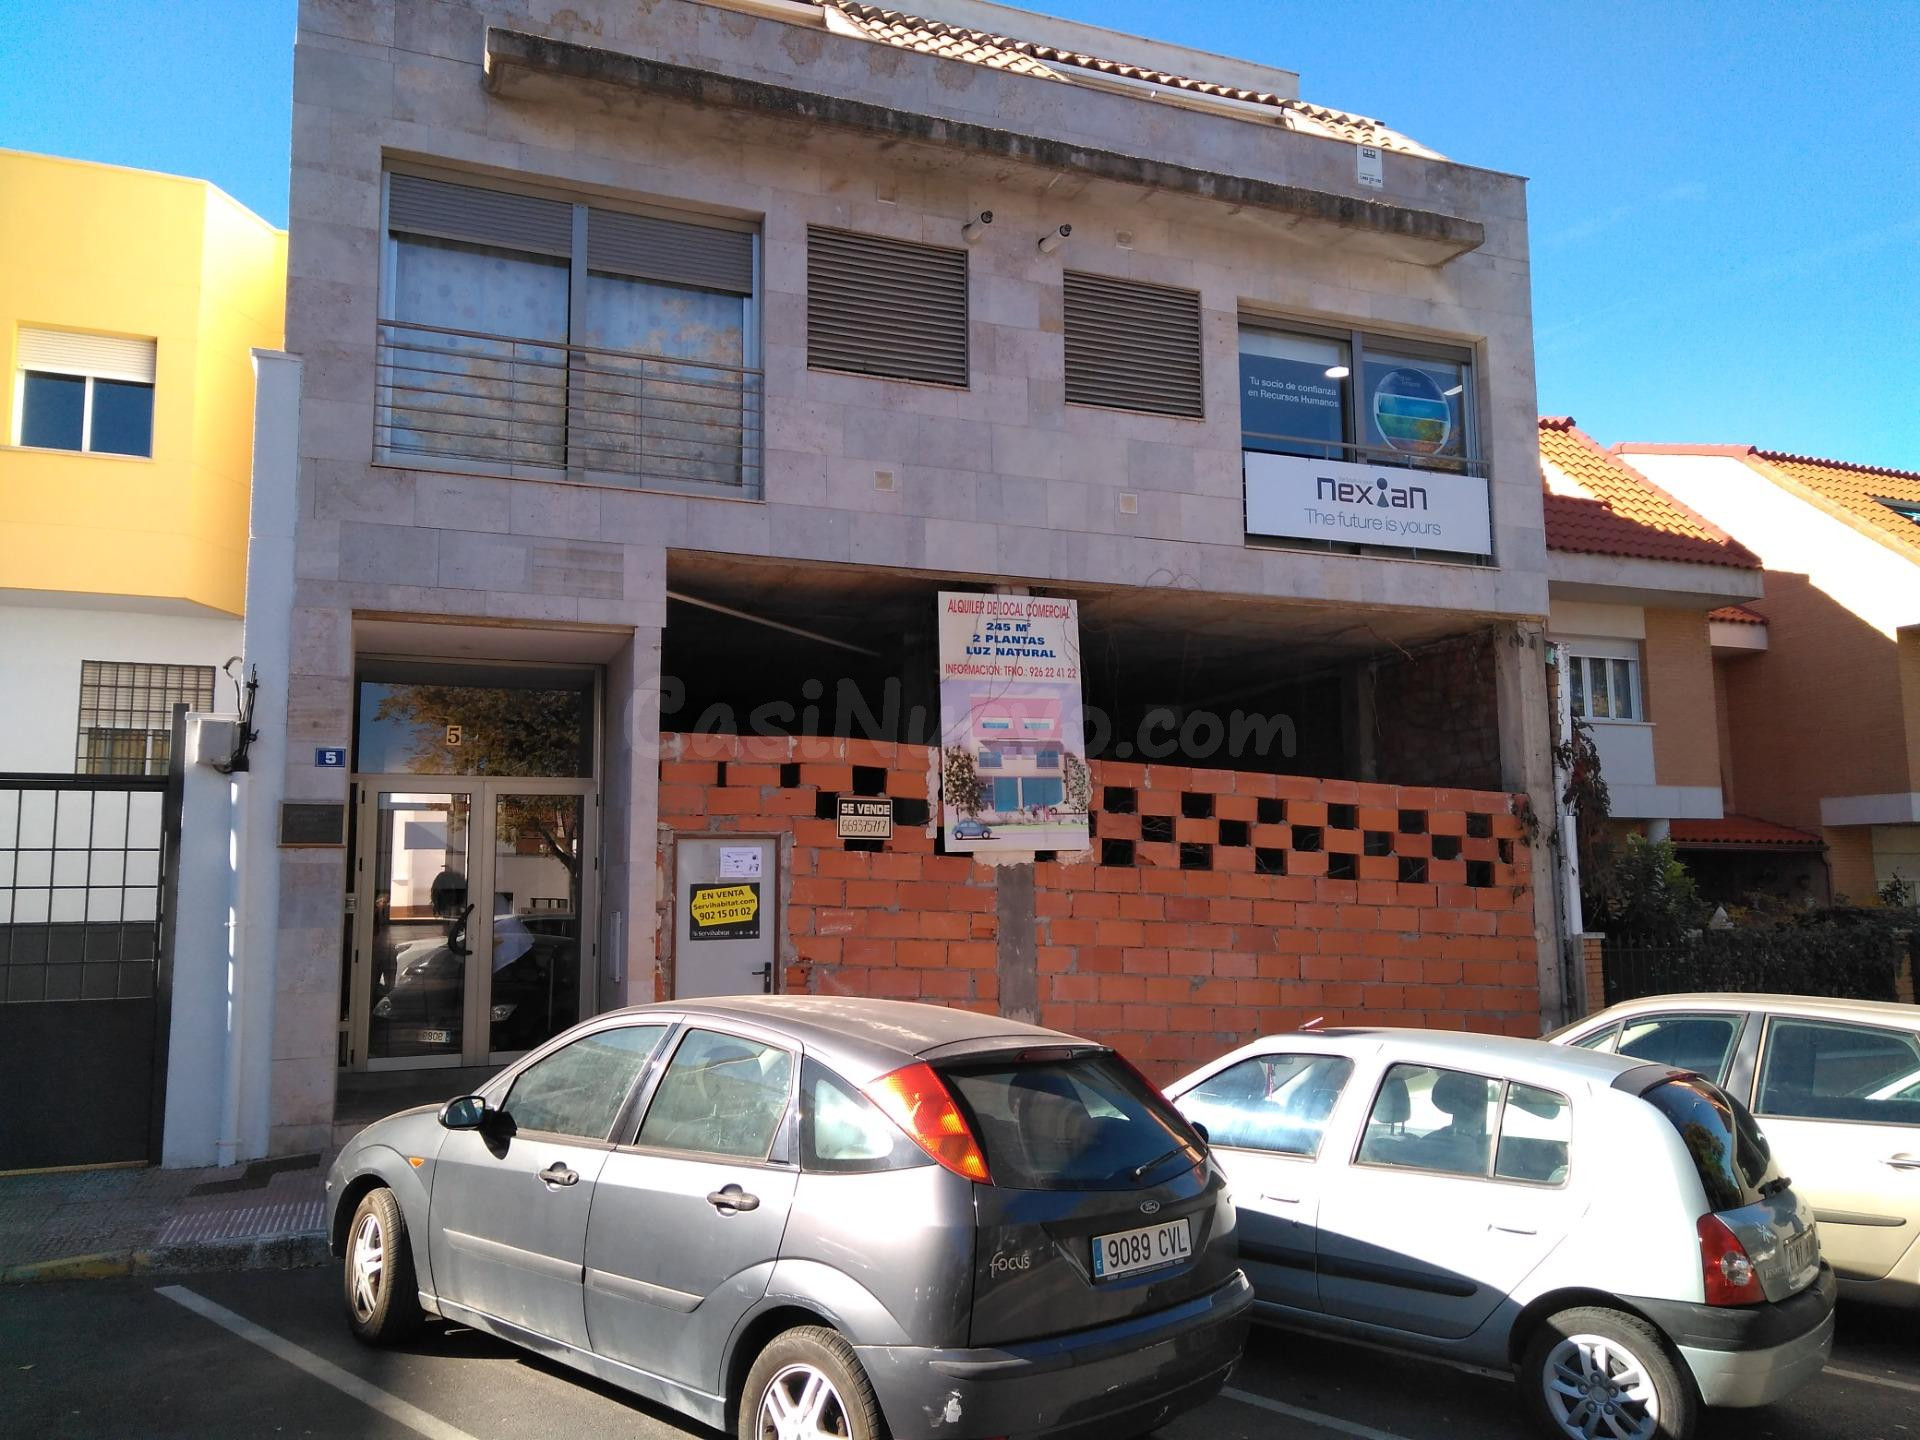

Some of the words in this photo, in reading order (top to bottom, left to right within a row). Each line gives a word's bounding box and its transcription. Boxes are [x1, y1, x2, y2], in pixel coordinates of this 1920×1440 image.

[1250, 376, 1259, 385] Tu
[1262, 379, 1283, 389] socio
[1286, 382, 1295, 390] de
[1298, 385, 1336, 395] confianza
[1248, 389, 1258, 397] en
[1260, 389, 1299, 402] Recursos
[1301, 395, 1339, 407] Humanos
[1304, 508, 1335, 525] The
[1338, 511, 1382, 530] future
[1386, 516, 1397, 531] is
[1400, 520, 1441, 535] yours
[948, 600, 984, 615] ALQUILER
[987, 602, 997, 615] DE
[999, 603, 1023, 616] LOCAL
[1026, 604, 1070, 619] COMERCIAL
[986, 622, 1010, 631] 245
[973, 634, 980, 642] 2
[986, 635, 1045, 645] PLANTAS
[966, 646, 991, 655] LUZ
[996, 647, 1056, 658] NATURAL
[1029, 667, 1043, 678] 926
[1045, 667, 1054, 677] 22
[1057, 668, 1065, 677] 41
[1068, 668, 1077, 678] 22
[448, 727, 459, 744] 5
[325, 752, 337, 764] 5
[841, 803, 854, 814] SE
[857, 804, 890, 815] VENDE
[716, 889, 745, 899] VENTA
[700, 911, 715, 920] 902
[717, 909, 727, 918] 15
[728, 908, 739, 917] 01
[741, 907, 751, 916] 02
[1108, 1238, 1151, 1268] 9089
[1158, 1227, 1187, 1257] CVL
